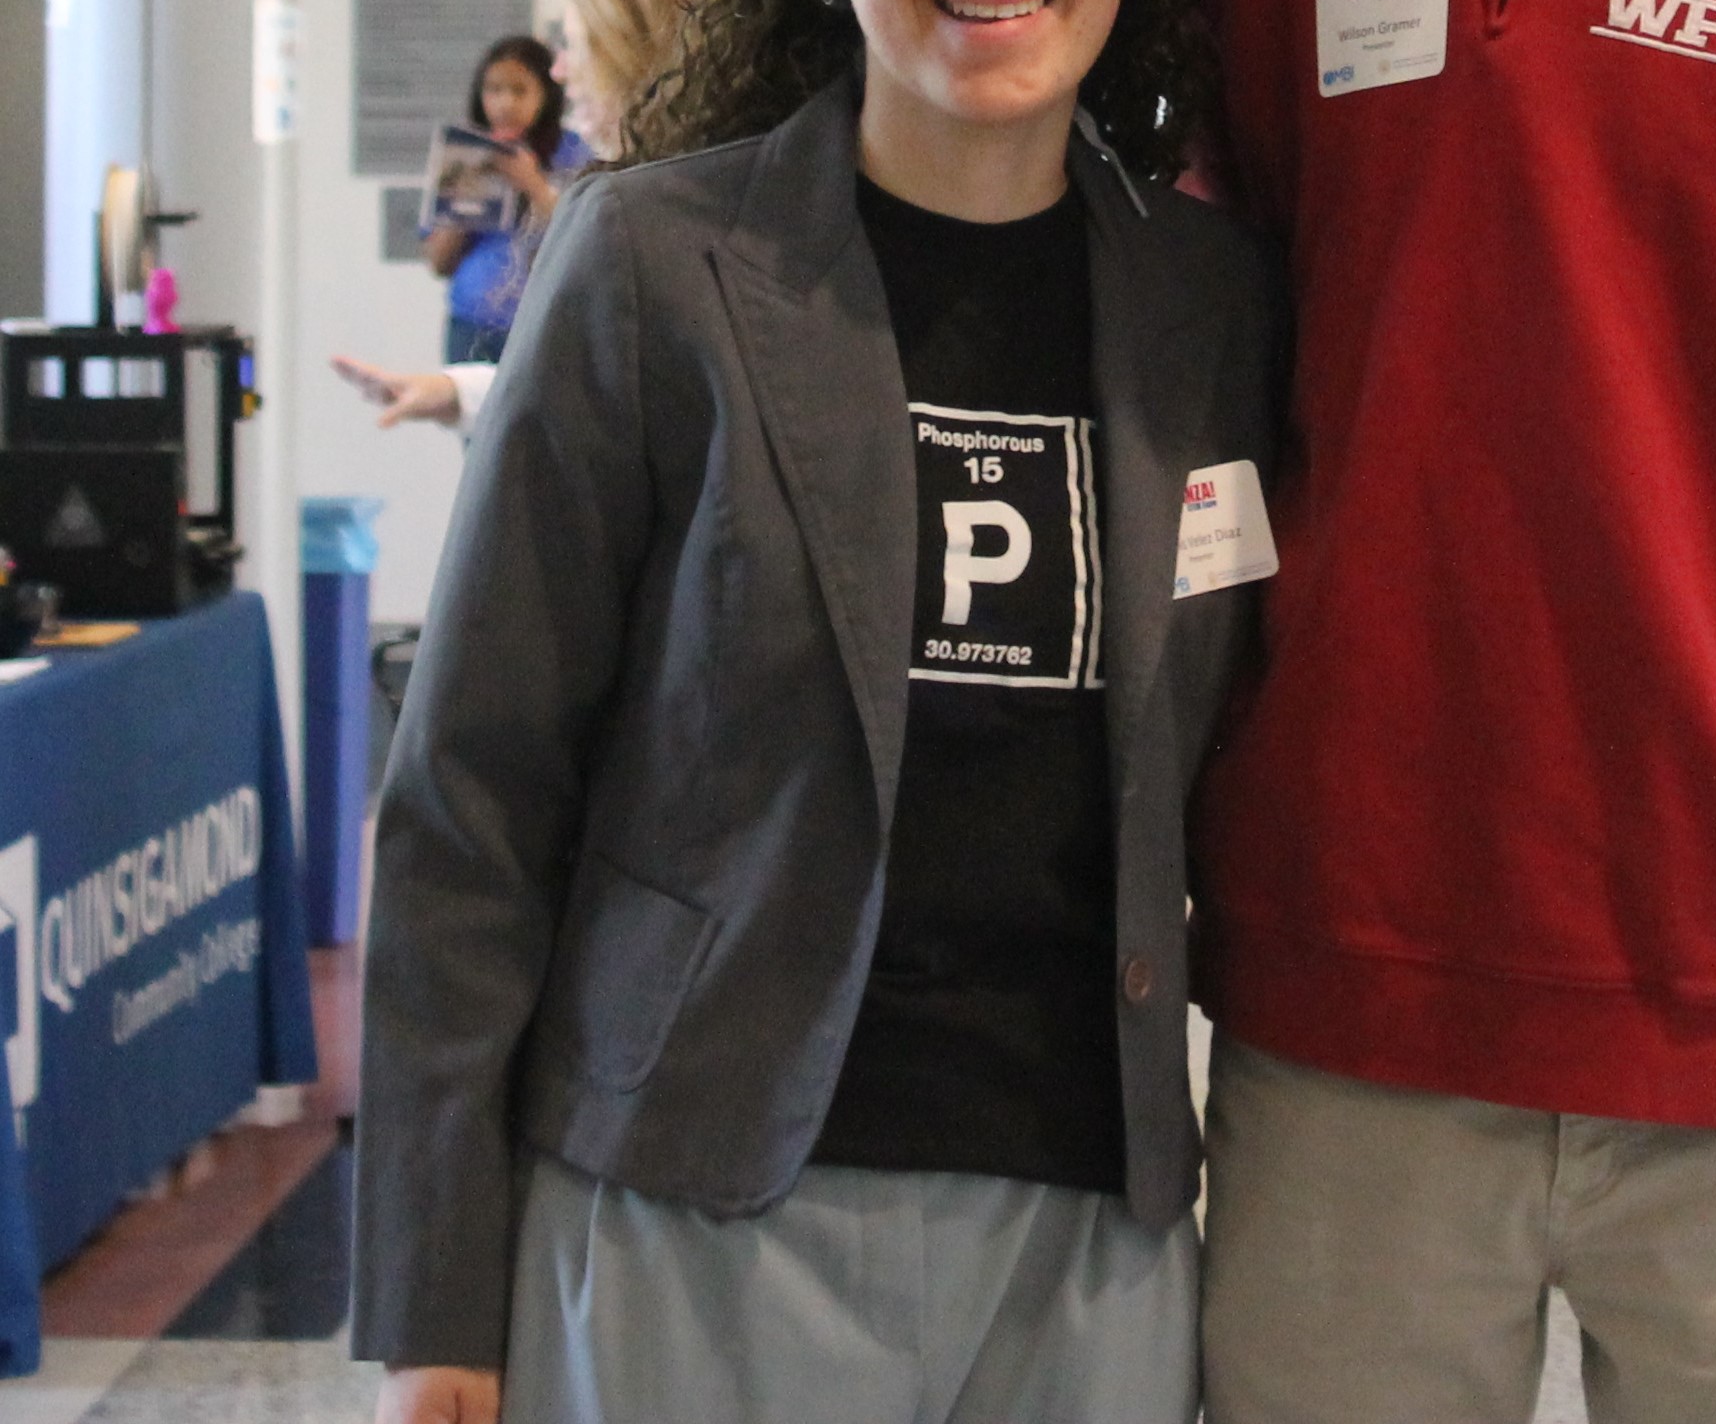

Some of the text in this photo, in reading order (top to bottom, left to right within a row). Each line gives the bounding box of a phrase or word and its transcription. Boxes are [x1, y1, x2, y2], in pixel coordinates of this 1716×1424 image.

[917, 422, 1045, 453] Phosphorous
[963, 457, 1004, 484] 15
[941, 500, 1033, 625] P
[924, 639, 1033, 666] 30.973762
[41, 785, 263, 1013] QUINSIGAMOND
